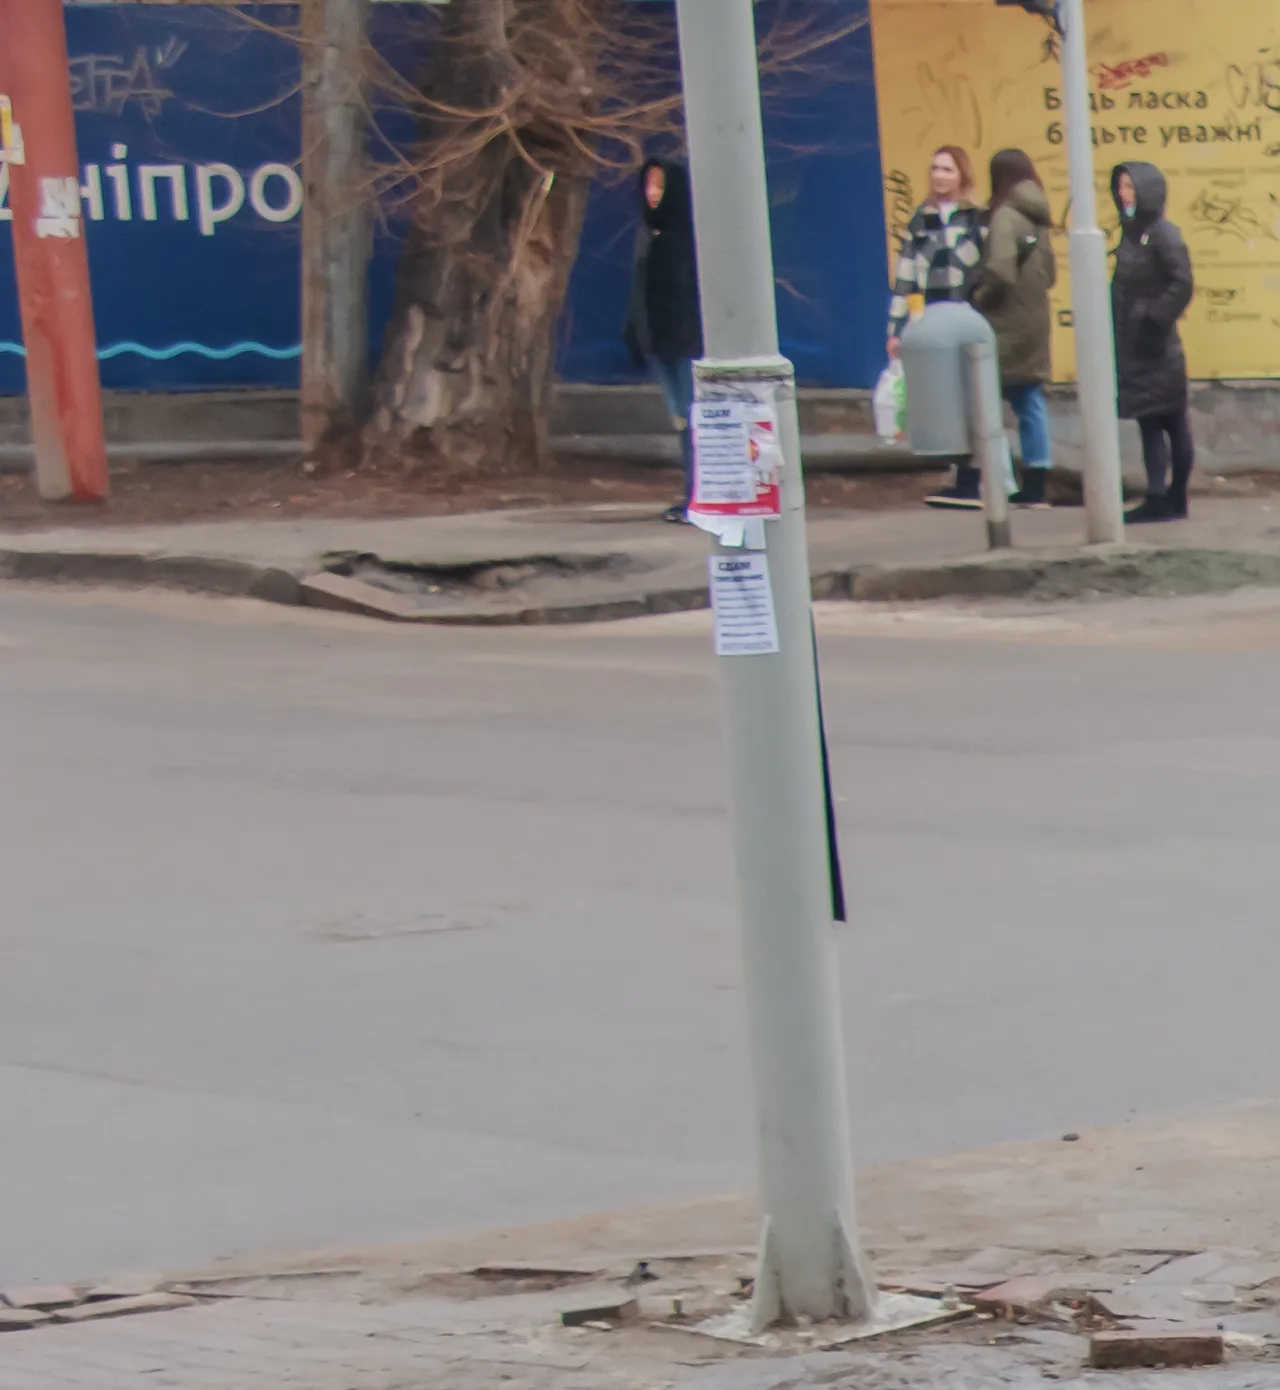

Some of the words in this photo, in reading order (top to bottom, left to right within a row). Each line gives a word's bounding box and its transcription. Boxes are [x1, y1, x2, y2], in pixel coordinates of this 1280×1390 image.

[1044, 87, 1116, 113] Бдь
[1127, 91, 1208, 110] ласка
[1047, 121, 1148, 148] бьте
[1158, 116, 1262, 148] уважні
[0, 143, 303, 237] ніпро
